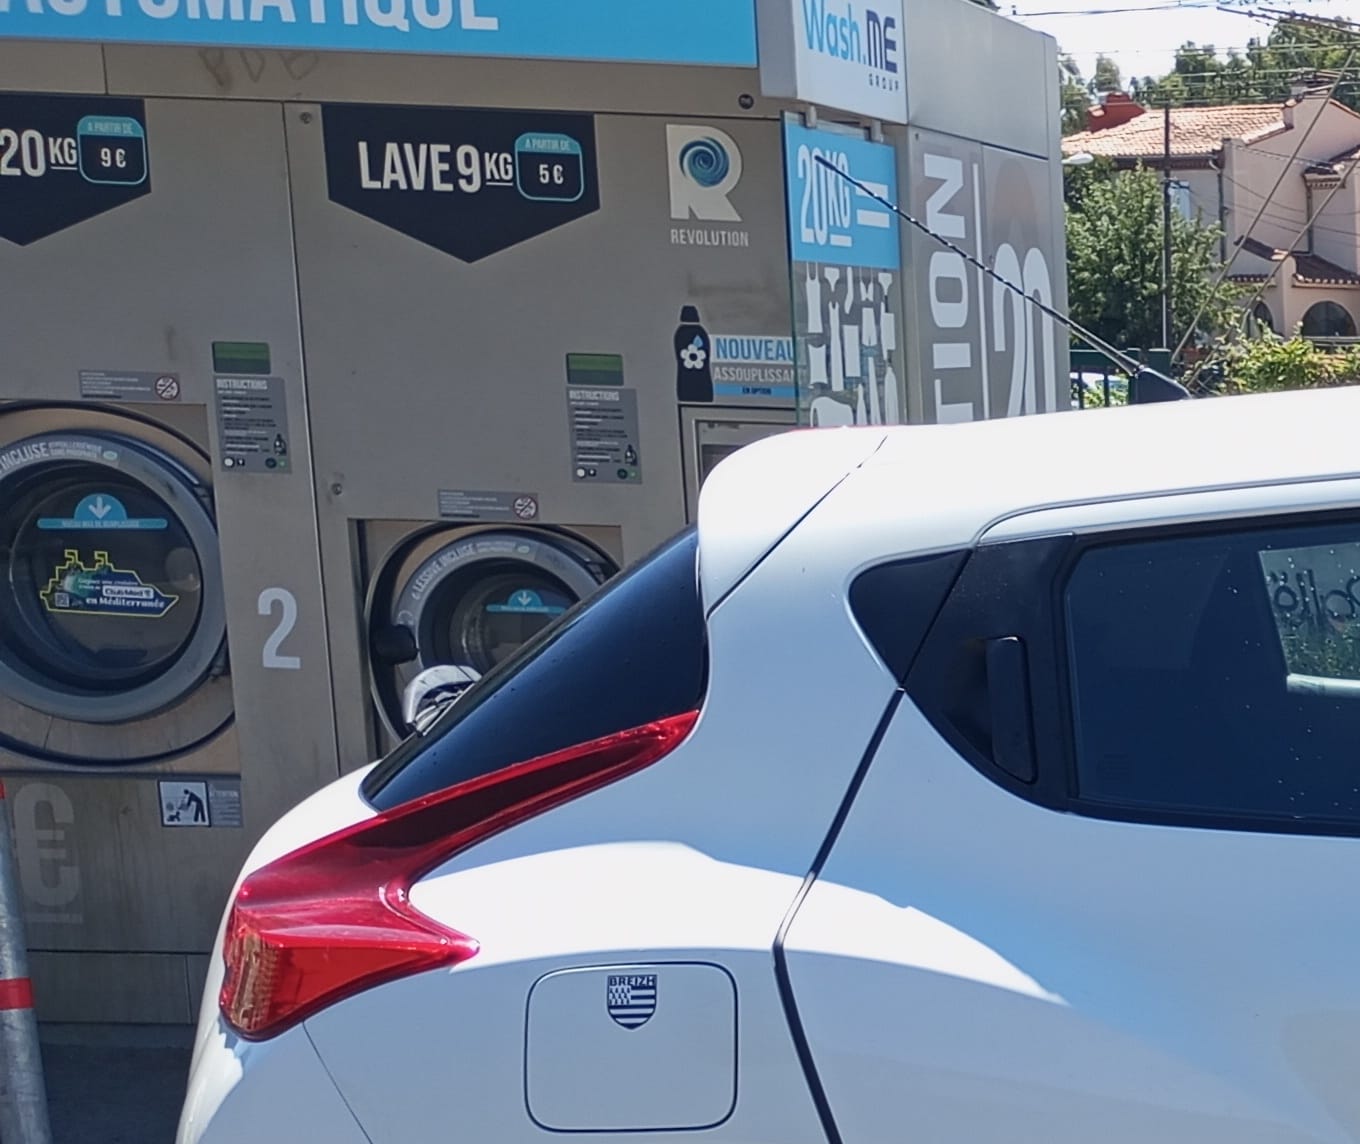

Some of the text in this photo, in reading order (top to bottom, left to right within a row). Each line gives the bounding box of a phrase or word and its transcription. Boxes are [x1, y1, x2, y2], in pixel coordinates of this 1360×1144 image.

[0, 128, 78, 177] 20 KG
[358, 141, 513, 193] LAVE 9 KG
[670, 228, 749, 247] REVOLUTION
[257, 587, 301, 669] 2
